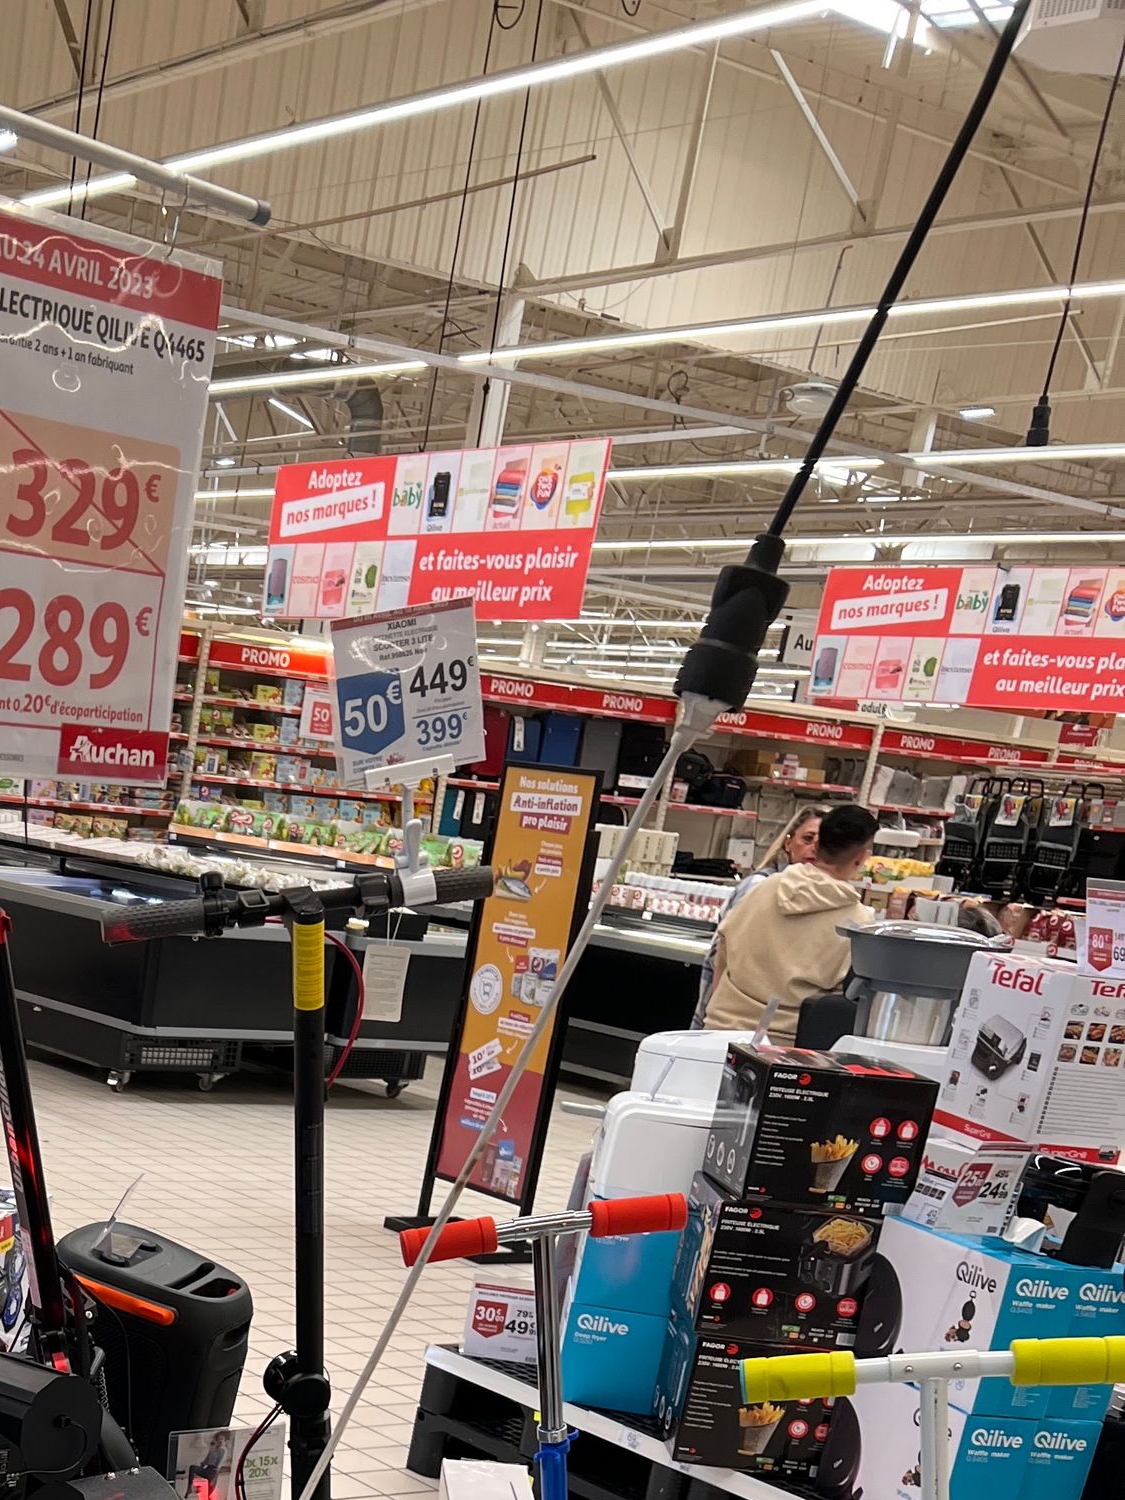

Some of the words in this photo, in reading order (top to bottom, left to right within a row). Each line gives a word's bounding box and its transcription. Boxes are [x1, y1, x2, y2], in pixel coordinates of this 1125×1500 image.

[23, 235, 45, 269] 24
[48, 243, 103, 286] AVRIL
[107, 265, 155, 300] 2023
[96, 313, 150, 349] QILIVE
[153, 323, 206, 363] Q4465
[43, 344, 60, 358] ans
[87, 351, 134, 376] fabriquant
[308, 469, 363, 493] Adoptez
[393, 485, 423, 510] baby
[286, 507, 310, 526] nos
[312, 495, 370, 523] marques
[419, 553, 434, 571] et
[436, 549, 523, 571] faites-vous
[525, 545, 579, 574] plaisir
[432, 586, 450, 601] au
[454, 580, 521, 601] meilleur
[521, 579, 553, 606] prix
[862, 574, 925, 593] Adoptez
[838, 605, 864, 621] nos
[865, 599, 931, 622] marques
[956, 591, 989, 613] baby
[387, 618, 417, 631] XIAOMI
[418, 634, 434, 646] LITE
[241, 647, 291, 668] PROMO
[983, 650, 1001, 666] et
[1002, 648, 1095, 669] faites-vous
[490, 679, 534, 698] PROMO
[995, 677, 1018, 693] au
[1019, 675, 1089, 696] meilleur
[1090, 678, 1125, 701] prix
[50, 699, 144, 725] d'écoparticipation
[602, 693, 644, 713] PROMO
[312, 708, 330, 723] 50
[713, 711, 748, 728] ROMO
[806, 722, 843, 740] PROMO
[70, 734, 155, 768] Auchan
[900, 734, 935, 752] PROMO
[987, 747, 1022, 762] PROMO
[519, 776, 536, 789] Nos
[537, 777, 579, 794] solutions
[513, 795, 578, 813] Anti-inflation
[522, 815, 536, 828] pro
[538, 815, 568, 832] plaisir
[991, 963, 1045, 996] Tefal
[773, 1072, 798, 1081] FAGOR
[725, 1206, 749, 1215] FAGOR
[956, 1261, 997, 1294] Qilive
[1016, 1278, 1070, 1301] Qilive
[1012, 1299, 1033, 1308] Waffle
[1035, 1302, 1056, 1310] maker
[1075, 1303, 1097, 1312] Waffle
[1099, 1306, 1120, 1314] maker
[577, 1313, 629, 1337] Qilive
[574, 1331, 591, 1341] Deep
[592, 1334, 608, 1344] fryer
[702, 1341, 725, 1350] FAGOR
[971, 1428, 1024, 1450] Qilive
[1033, 1430, 1088, 1452] Qilive
[967, 1449, 989, 1458] Waffle
[991, 1451, 1011, 1459] maker
[1030, 1451, 1052, 1460] Waffle
[1054, 1453, 1075, 1462] maker
